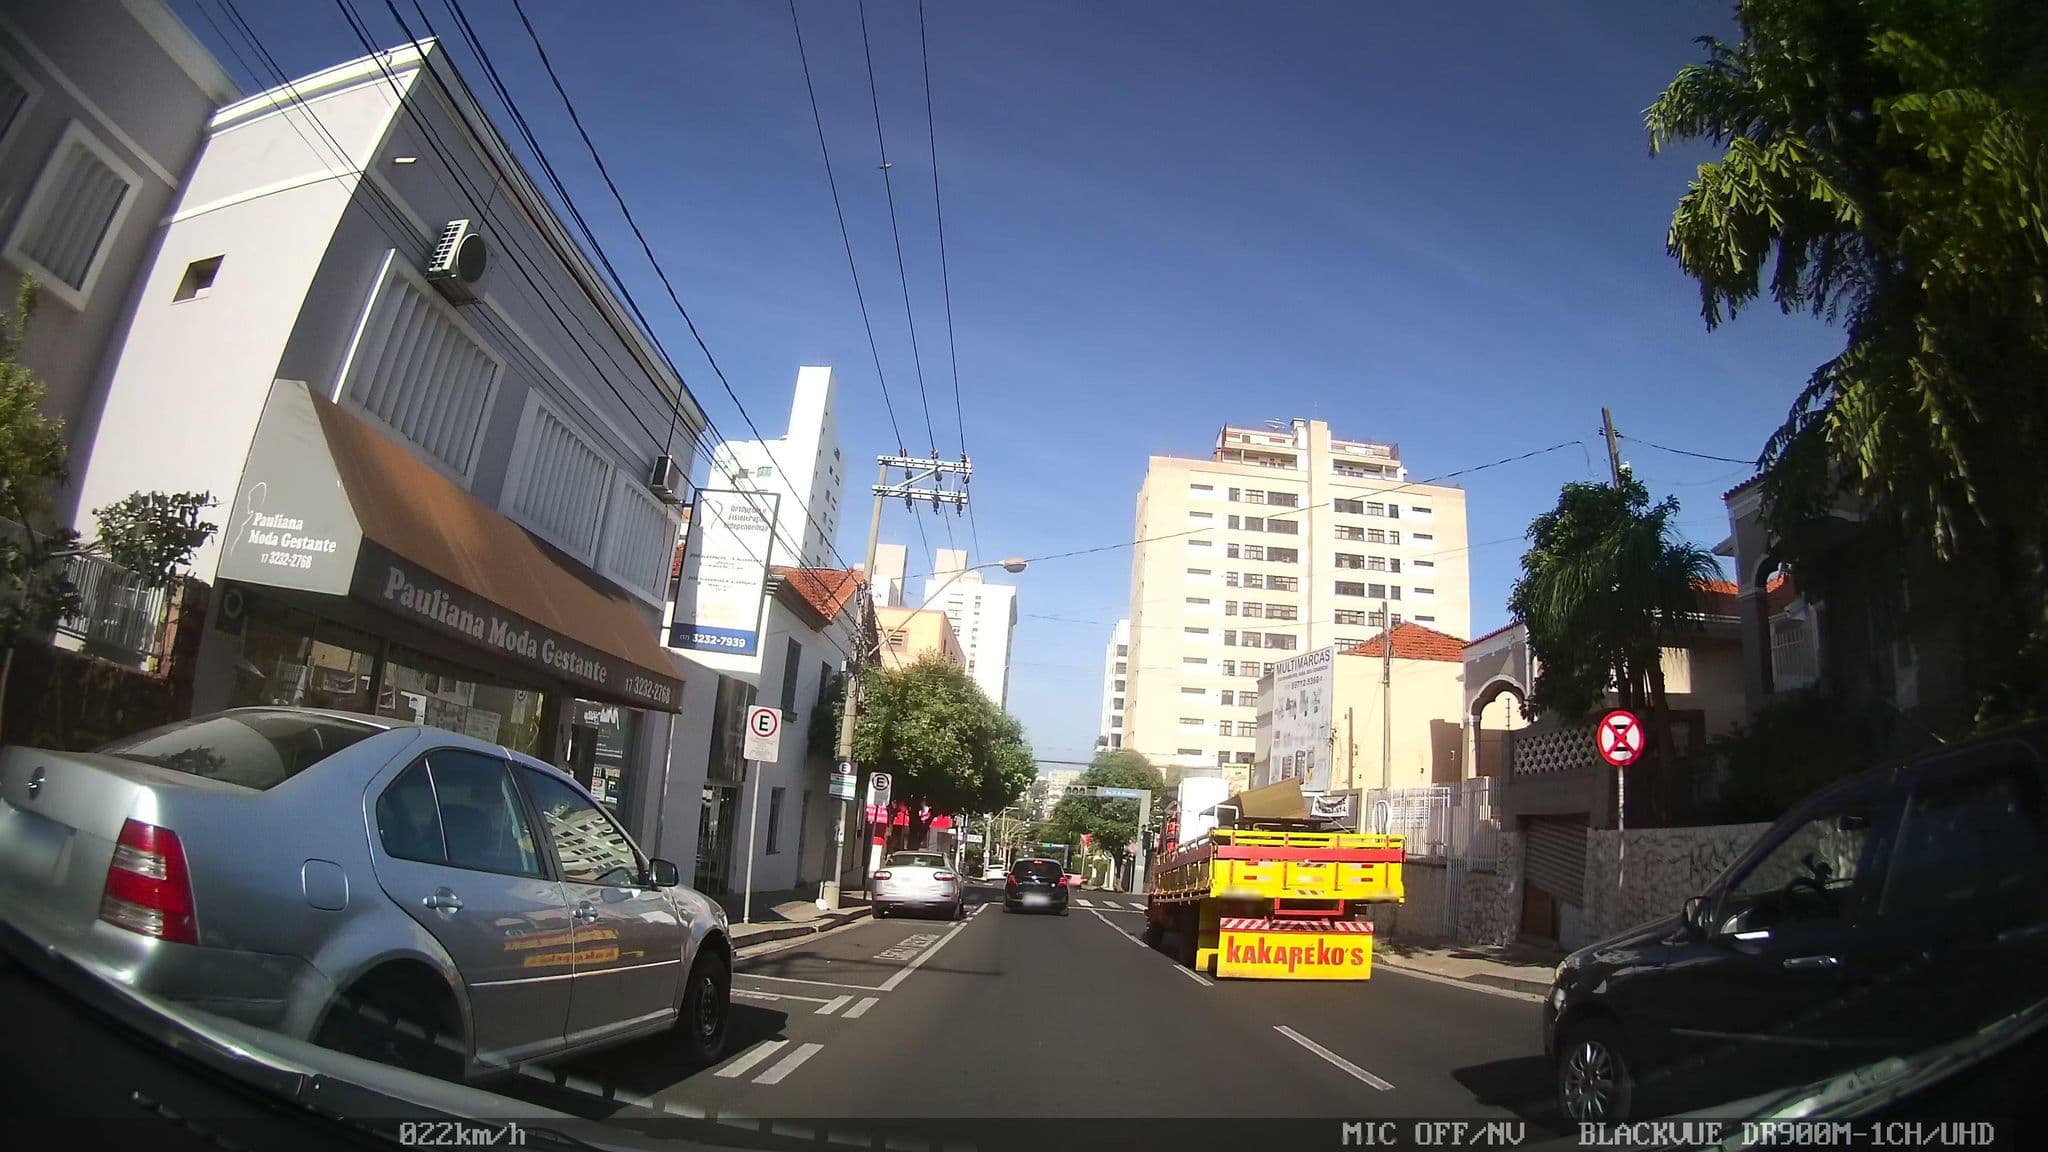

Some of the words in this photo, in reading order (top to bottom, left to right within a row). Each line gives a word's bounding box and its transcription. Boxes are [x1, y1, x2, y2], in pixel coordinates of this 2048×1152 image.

[252, 512, 304, 530] Pauliana
[248, 529, 279, 546] Moda
[281, 533, 337, 553] Gestante
[261, 553, 269, 564] 17
[269, 551, 313, 569] 3232-2768
[384, 567, 485, 637] Pauliana
[488, 616, 538, 660] Moda
[542, 639, 608, 684] Gestante
[692, 633, 746, 648] 3232-7939
[625, 678, 633, 693] 17
[633, 676, 671, 705] 3232-2768
[759, 715, 770, 731] E
[841, 764, 848, 772] E
[876, 777, 885, 788] E
